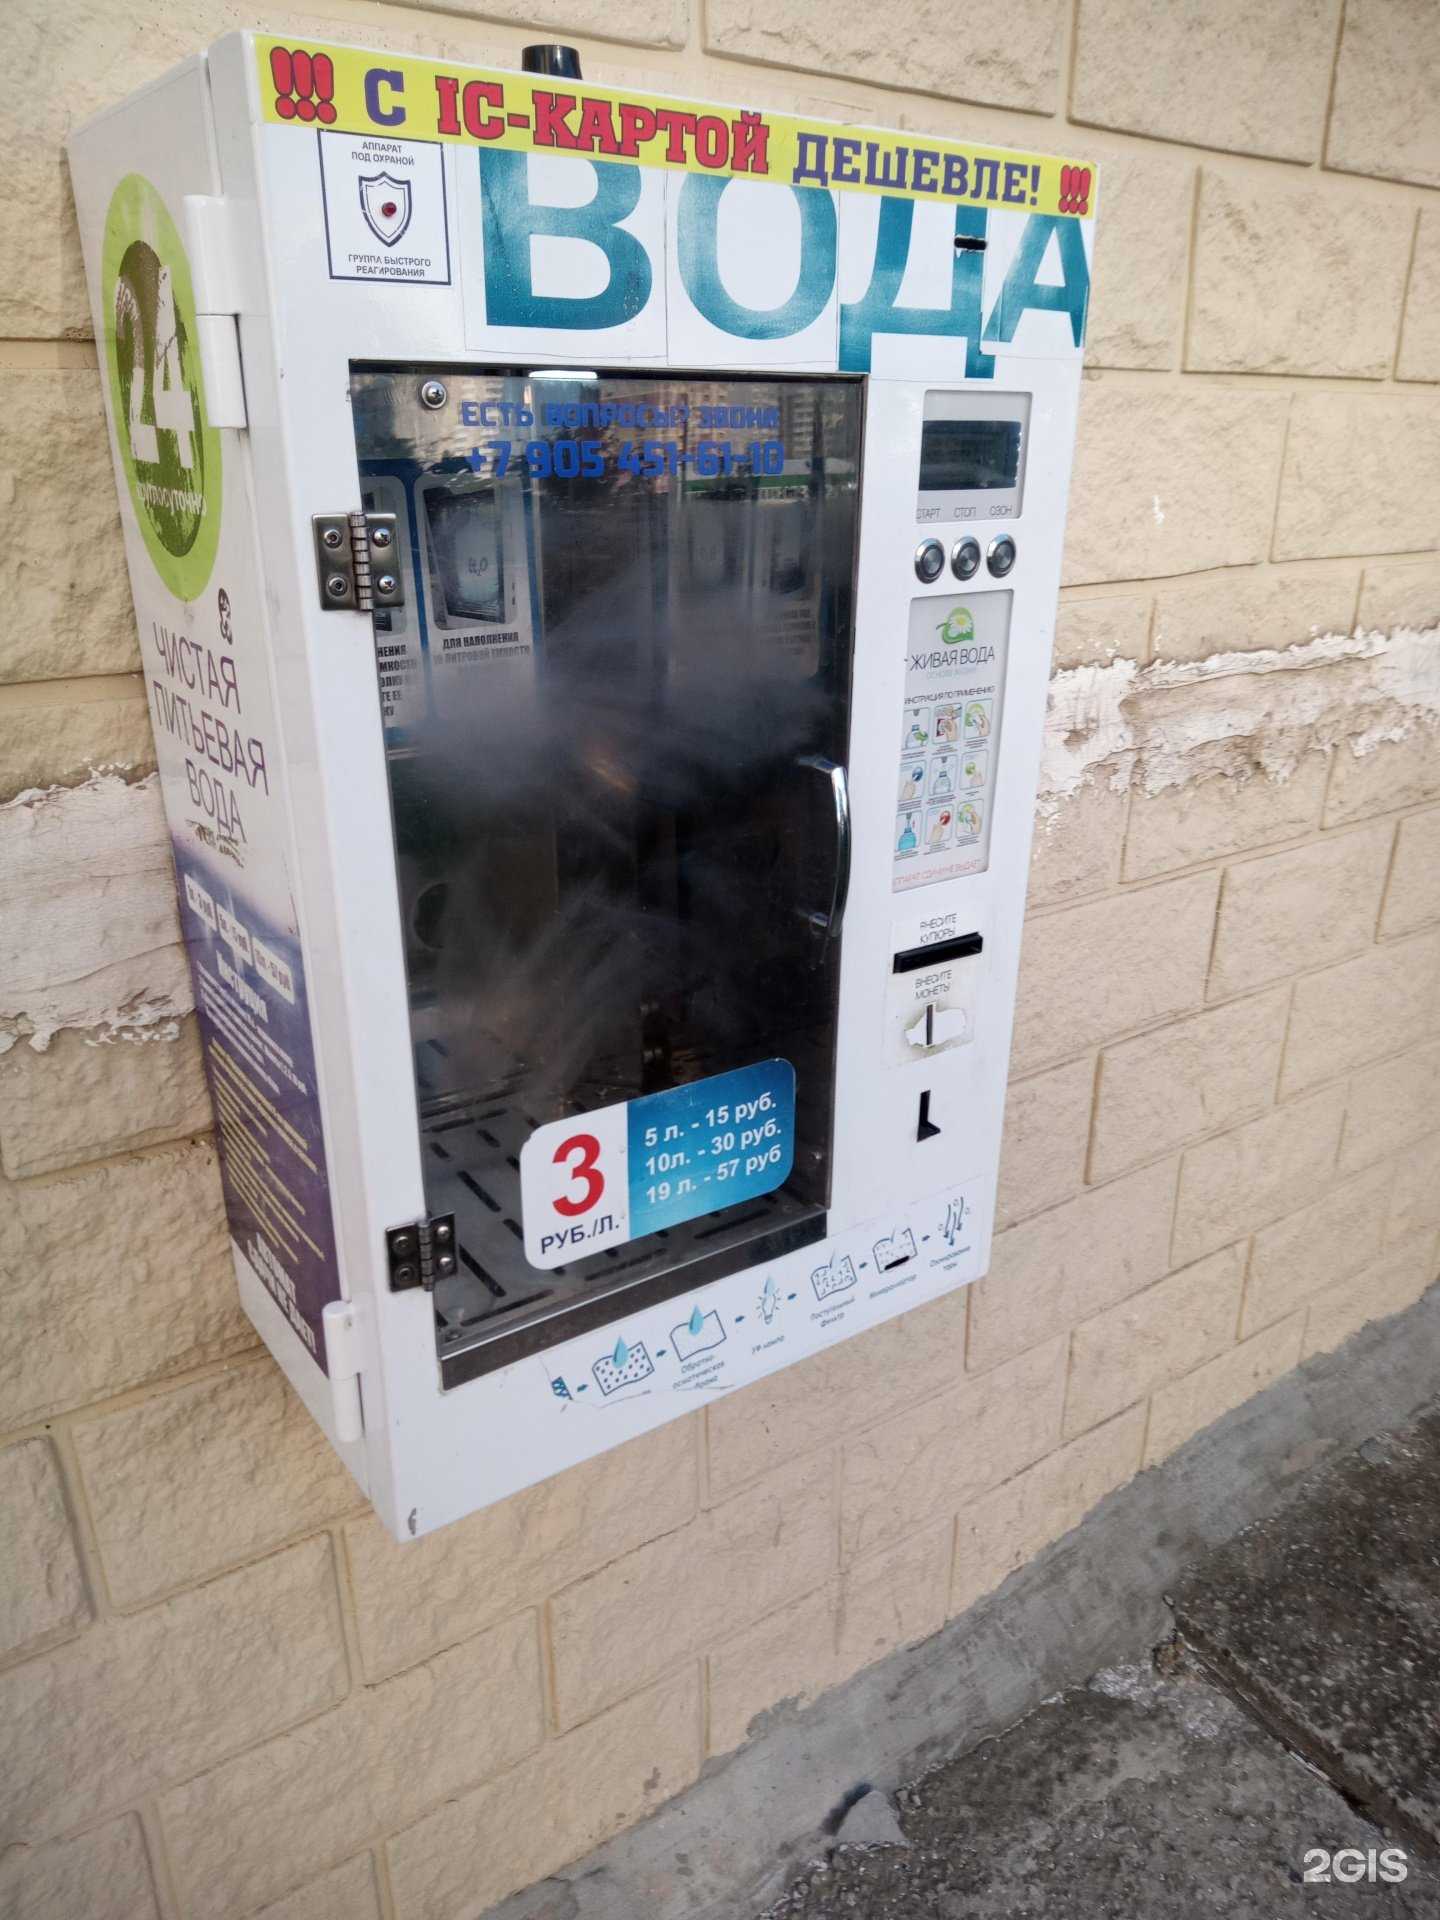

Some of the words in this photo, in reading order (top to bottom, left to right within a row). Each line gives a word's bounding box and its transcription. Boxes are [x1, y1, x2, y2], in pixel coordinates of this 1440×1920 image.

[269, 46, 337, 125] !!!
[364, 68, 406, 127] С
[792, 131, 1041, 206] ДЕШЕВЛЕ!
[1058, 164, 1092, 216] !!!
[362, 141, 403, 153] АППАРАТ
[351, 151, 371, 163] ПОД
[373, 153, 415, 166] ОХРАНОЙ
[348, 253, 383, 265] ГРУППА
[384, 255, 432, 268] БЫСТРОГО
[356, 265, 426, 278] РЕАГИРОВАНИЯ
[478, 144, 1092, 380] ВОДА
[461, 401, 534, 427] ЕСТЬ
[464, 440, 512, 480] +7
[524, 440, 606, 479] 905
[616, 439, 785, 478] 451-61-10
[152, 621, 241, 715] ЧИСТАЯ
[909, 649, 958, 671] ЖИВАЯ
[959, 645, 996, 665] ВОДА
[152, 680, 269, 797] ПИТЬЕВАЯ
[185, 757, 247, 844] ВОДА
[645, 1127, 658, 1147] 5
[664, 1122, 685, 1142] л.
[706, 1108, 729, 1127] 15
[735, 1091, 777, 1125] руб.
[711, 1133, 735, 1155] 30
[741, 1118, 782, 1149] руб.
[552, 1133, 605, 1217] 3
[646, 1184, 671, 1204] 19
[677, 1176, 697, 1195] л.
[717, 1159, 740, 1181] 57
[746, 1144, 782, 1175] руб
[540, 1214, 620, 1254] РУБ./Л.
